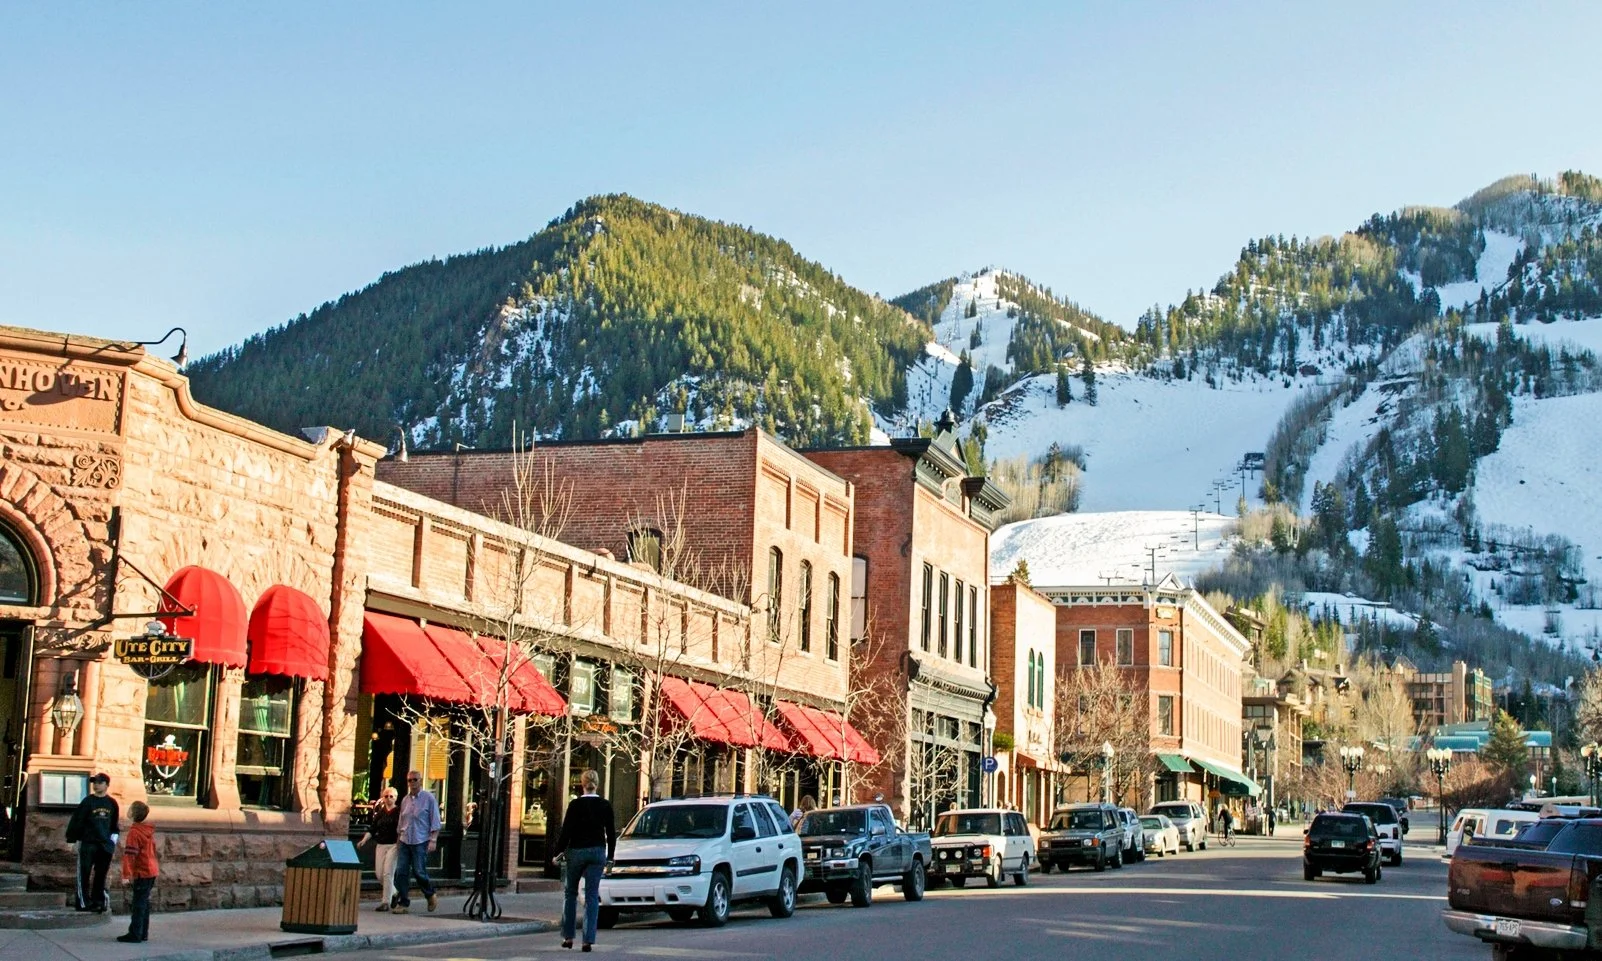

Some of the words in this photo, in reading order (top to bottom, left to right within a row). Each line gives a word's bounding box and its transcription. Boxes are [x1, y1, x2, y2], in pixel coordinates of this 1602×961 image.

[115, 640, 148, 656] UTE
[150, 640, 188, 655] CITY
[985, 758, 994, 770] P
